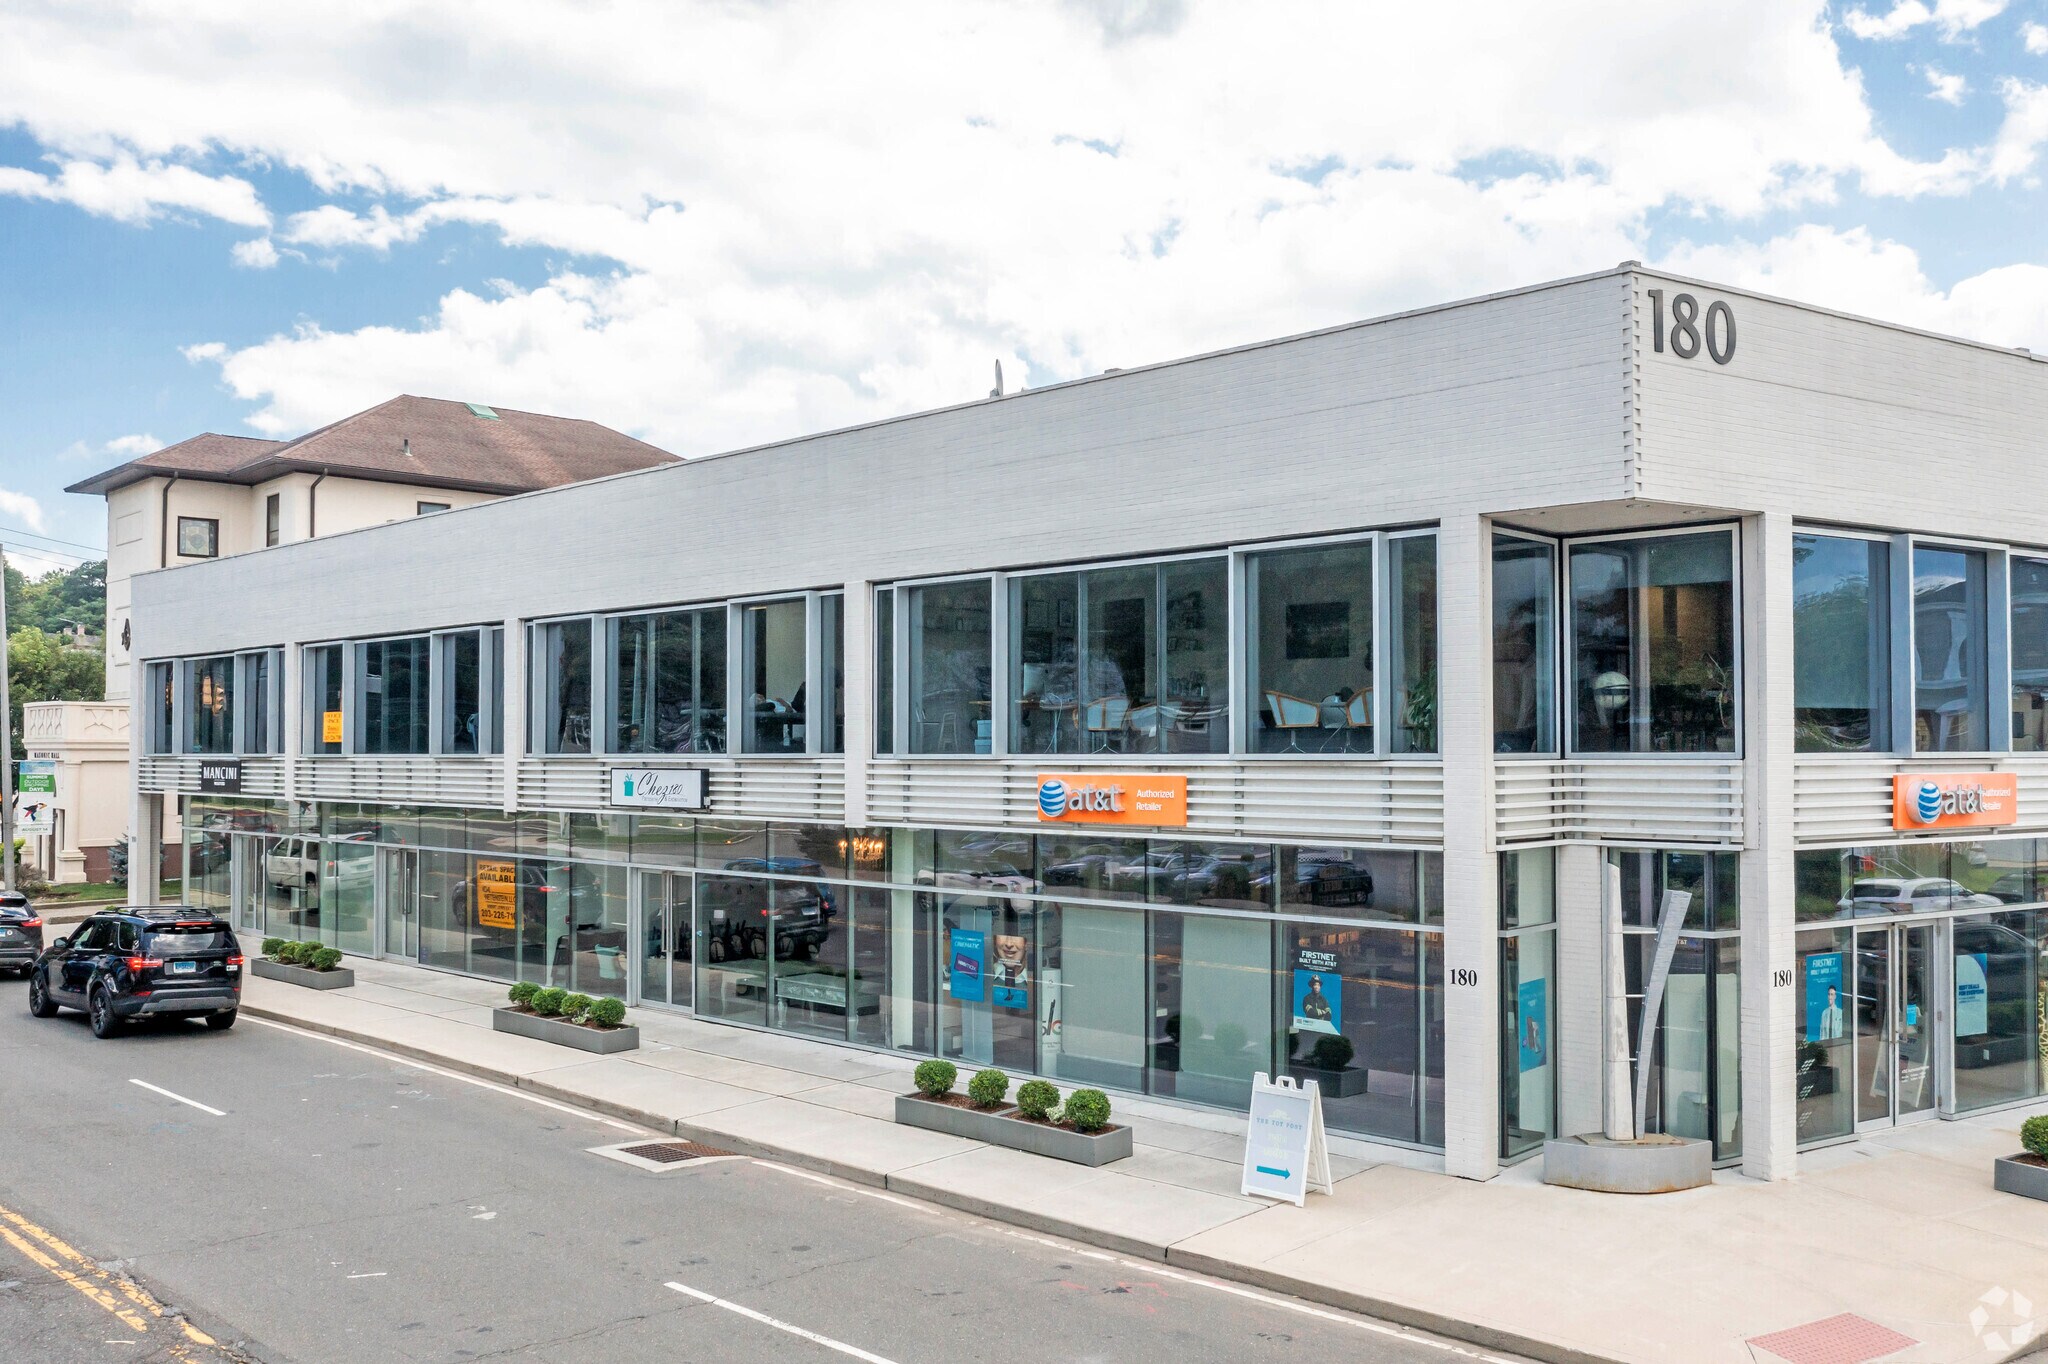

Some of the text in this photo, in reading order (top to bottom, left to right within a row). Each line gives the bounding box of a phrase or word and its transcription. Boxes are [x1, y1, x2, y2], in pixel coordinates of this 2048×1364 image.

[1648, 289, 1736, 365] 180
[203, 767, 237, 780] MANCINI
[1068, 783, 1122, 812] at&t
[1136, 789, 1175, 799] Authorized
[1944, 784, 1986, 815] at&t
[1136, 801, 1162, 811] Retailer
[479, 864, 498, 872] RETAIL
[1299, 957, 1311, 965] BUILT
[1301, 950, 1337, 961] FIRSTNET
[1812, 957, 1837, 967] FIRSTNET
[1450, 968, 1478, 987] 180
[1773, 969, 1792, 988] 180
[1271, 1119, 1284, 1127] TOT
[1286, 1122, 1303, 1131] POST
